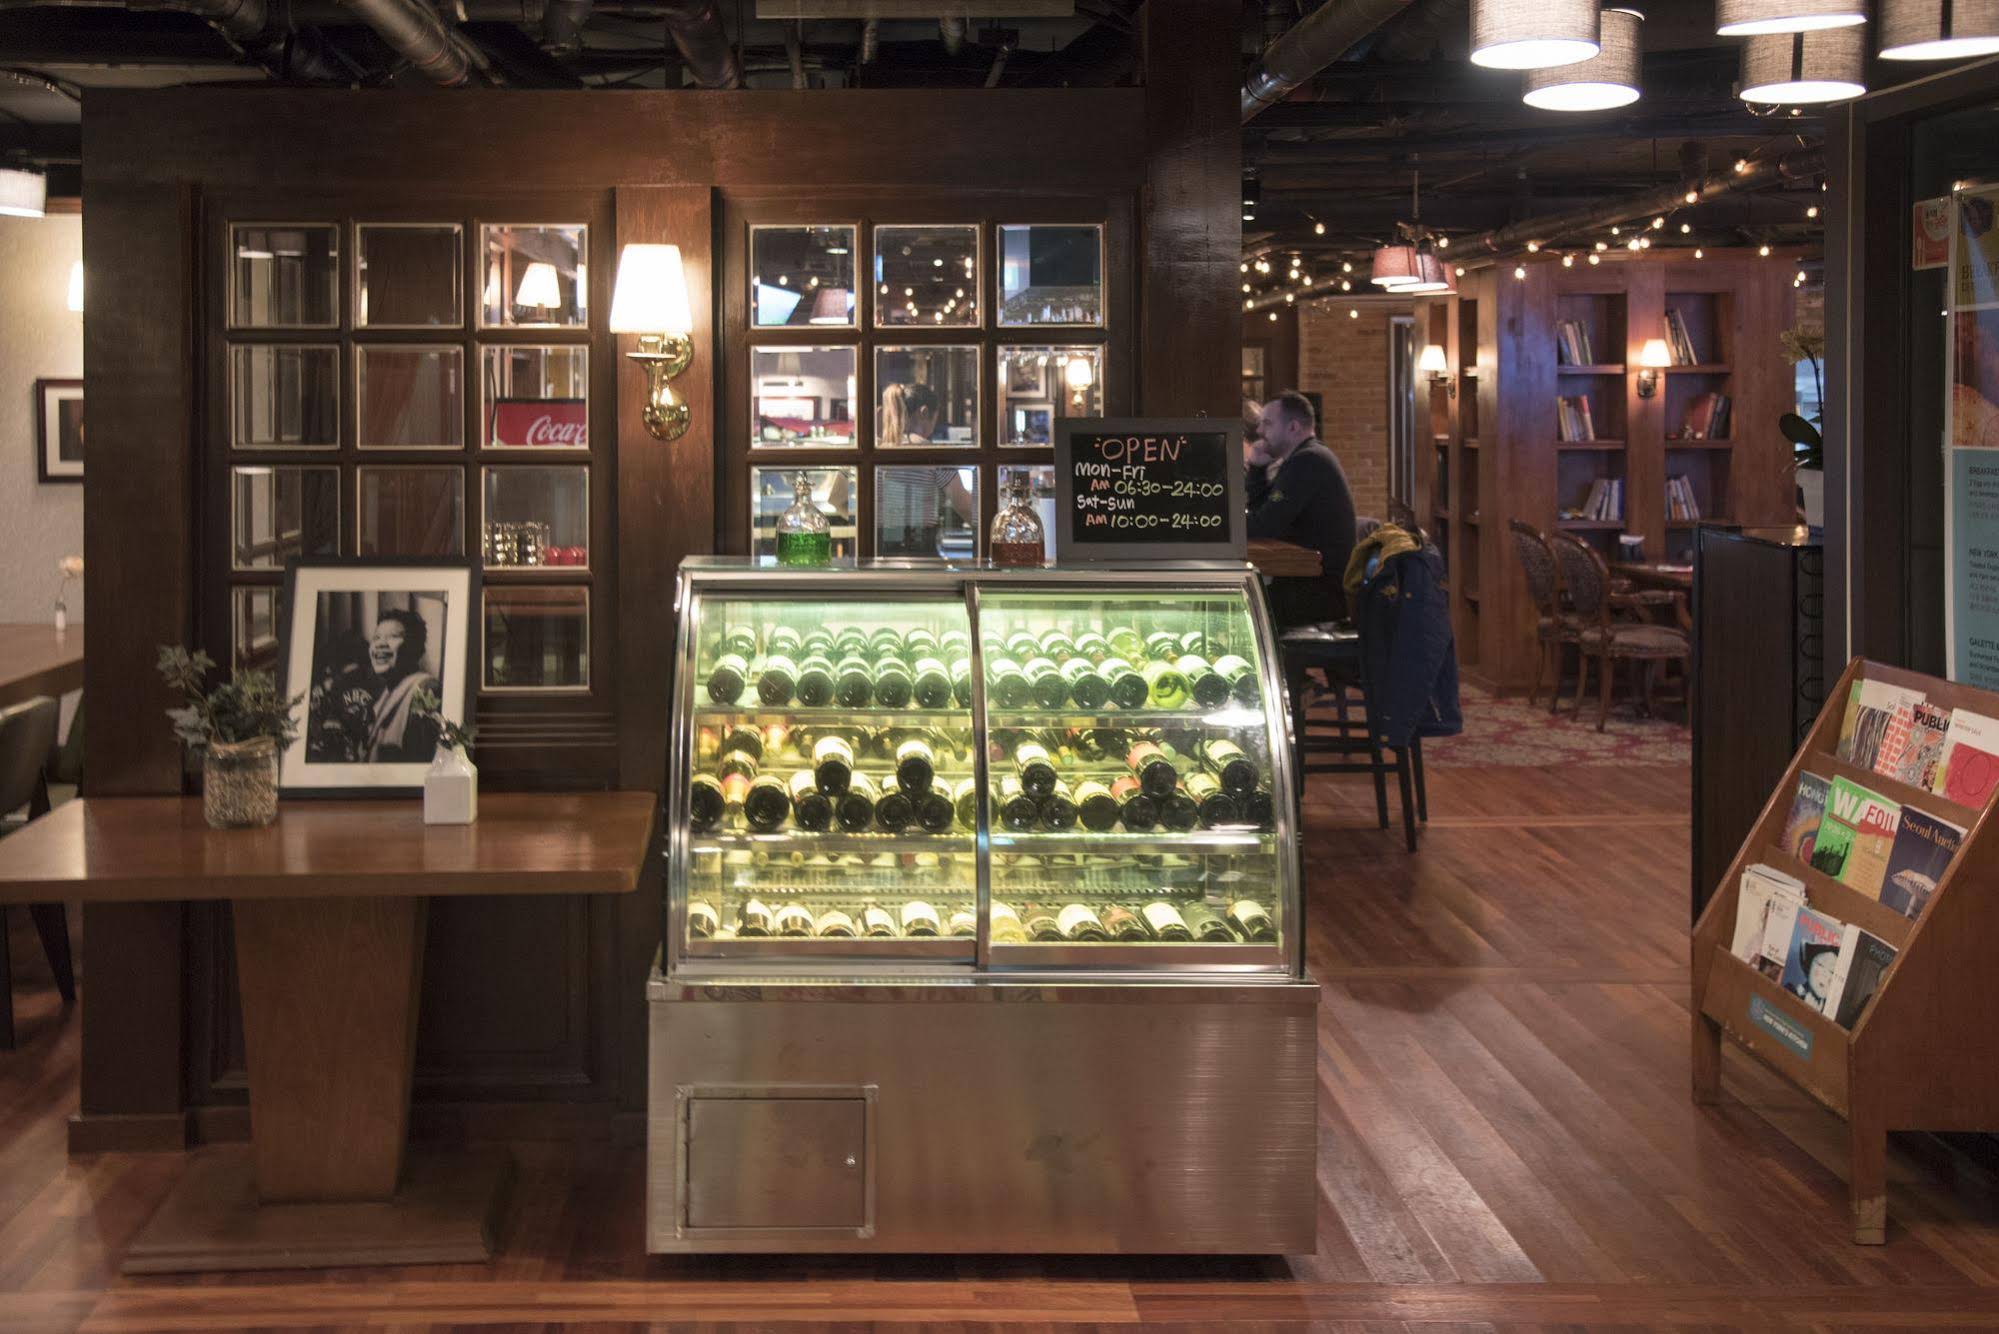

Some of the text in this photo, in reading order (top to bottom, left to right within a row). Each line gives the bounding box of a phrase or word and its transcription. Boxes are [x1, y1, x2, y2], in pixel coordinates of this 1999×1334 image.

[1101, 437, 1182, 464] OPEN
[1075, 462, 1146, 481] Mon-Fri
[1090, 478, 1111, 491] AM
[1076, 494, 1136, 511] Sat-Sun
[1085, 514, 1108, 527] AM
